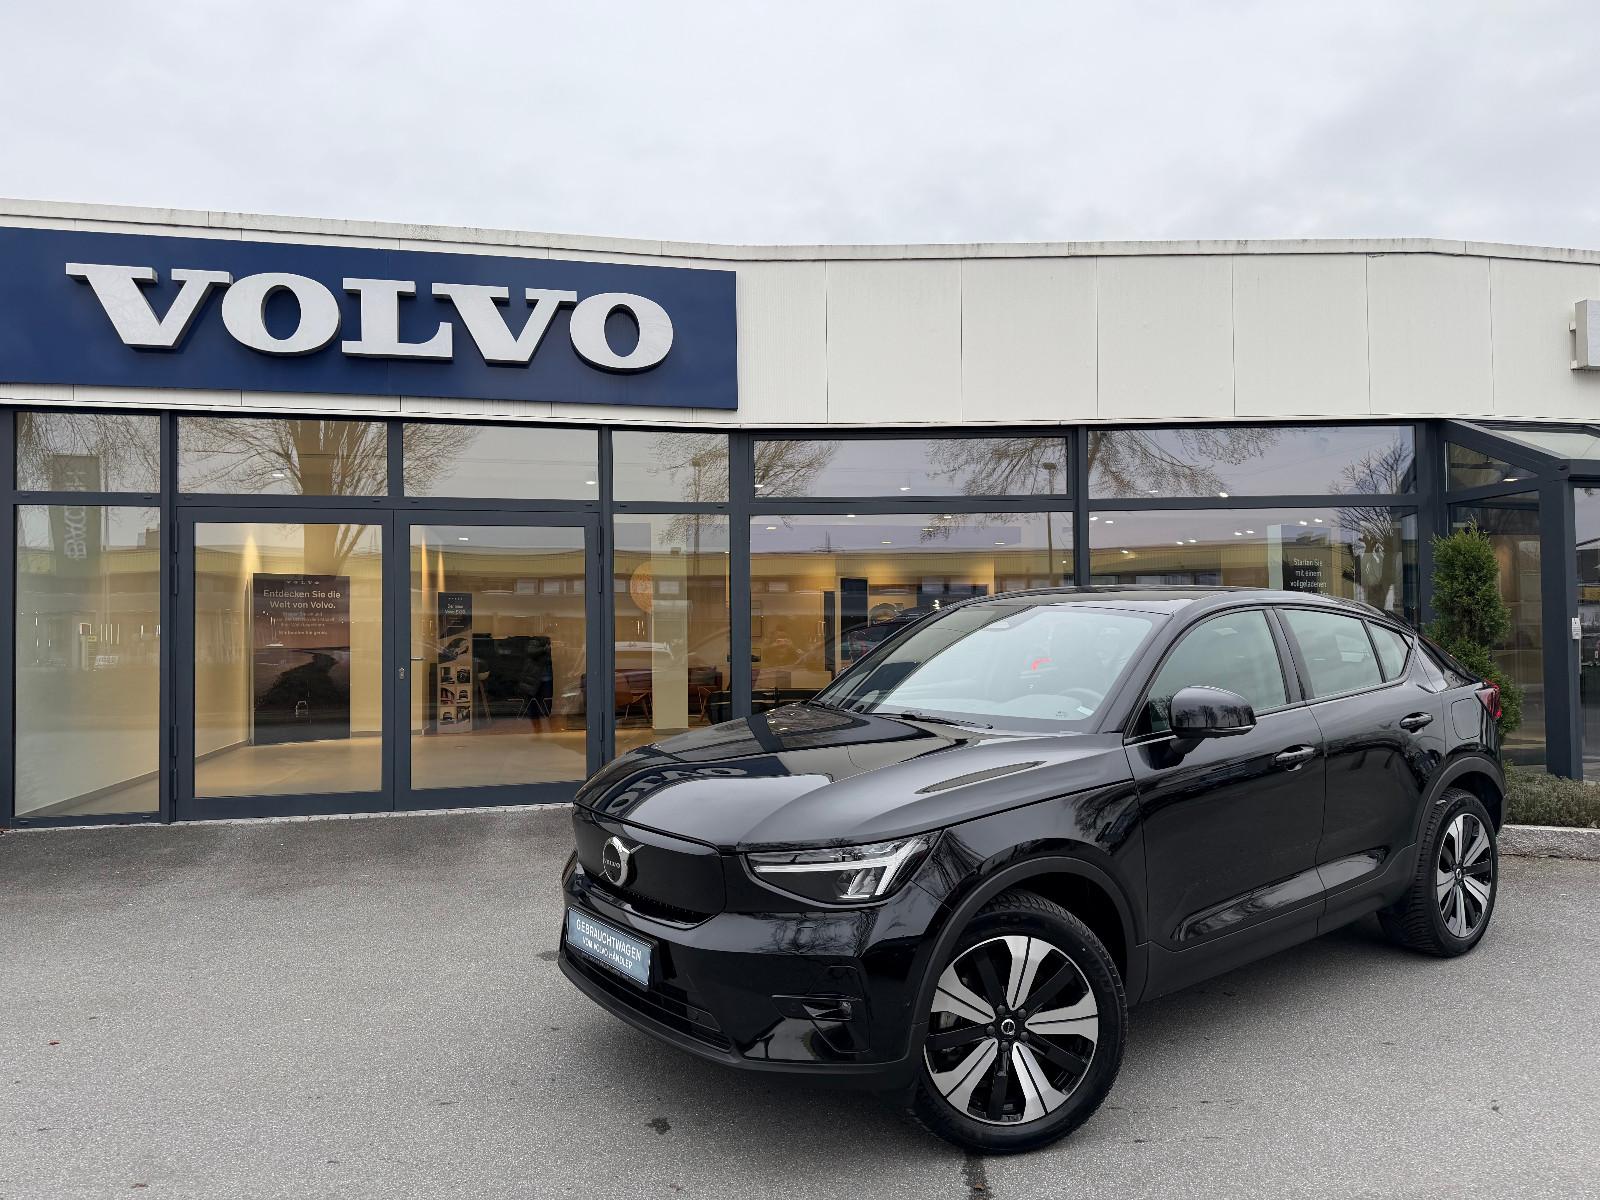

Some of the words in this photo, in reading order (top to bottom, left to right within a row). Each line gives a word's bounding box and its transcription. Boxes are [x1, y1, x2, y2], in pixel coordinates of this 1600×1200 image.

[65, 262, 674, 371] VOLVO
[263, 589, 310, 598] Entdecken
[311, 590, 325, 598] Sie
[327, 590, 341, 599] die
[269, 600, 291, 609] Welt
[310, 601, 336, 609] Volvo.
[576, 918, 642, 962] GEBRAUCHTWAGEN
